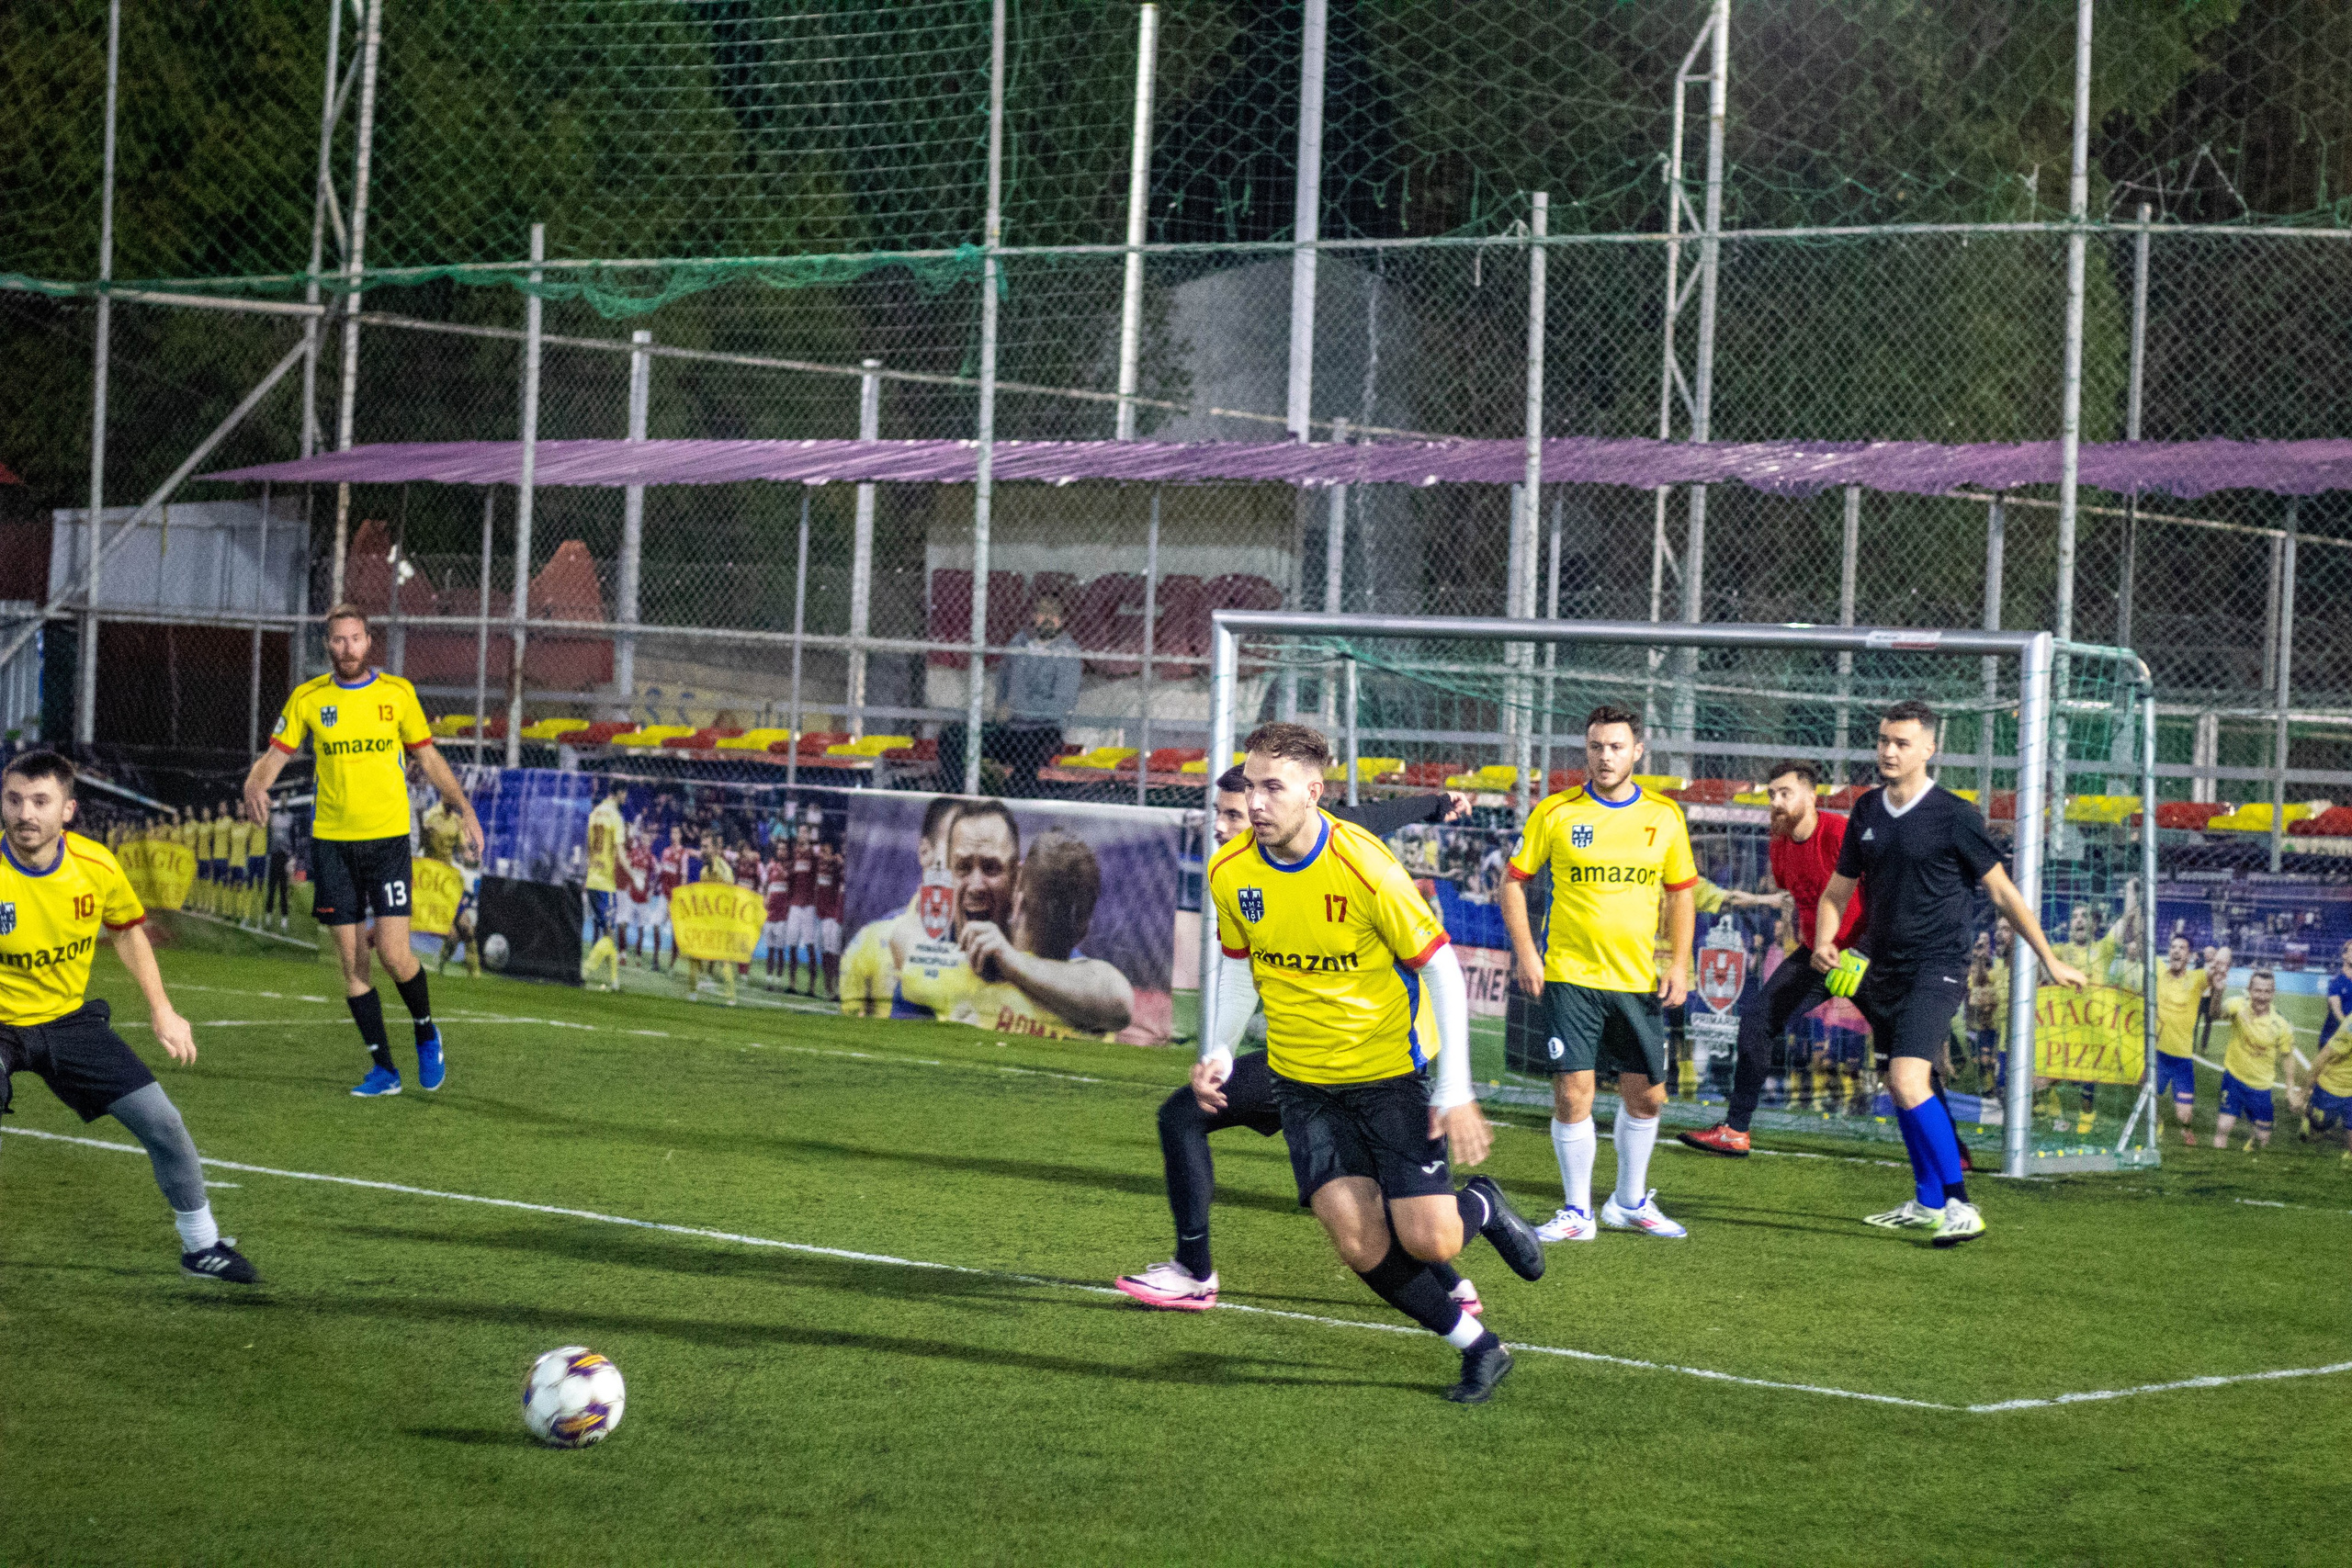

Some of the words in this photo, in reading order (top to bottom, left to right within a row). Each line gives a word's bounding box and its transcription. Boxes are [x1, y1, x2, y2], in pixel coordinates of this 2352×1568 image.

[378, 704, 394, 721] 13
[322, 739, 393, 755] amazon
[1645, 827, 1657, 846] 7
[1570, 866, 1656, 886] amazon
[384, 880, 407, 907] 13
[73, 894, 95, 920] 10
[1324, 894, 1348, 923] 17
[0, 935, 92, 970] mazon
[1252, 950, 1358, 972] amazon
[2034, 998, 2142, 1036] MAGIC
[2046, 1041, 2124, 1072] PIZZA
